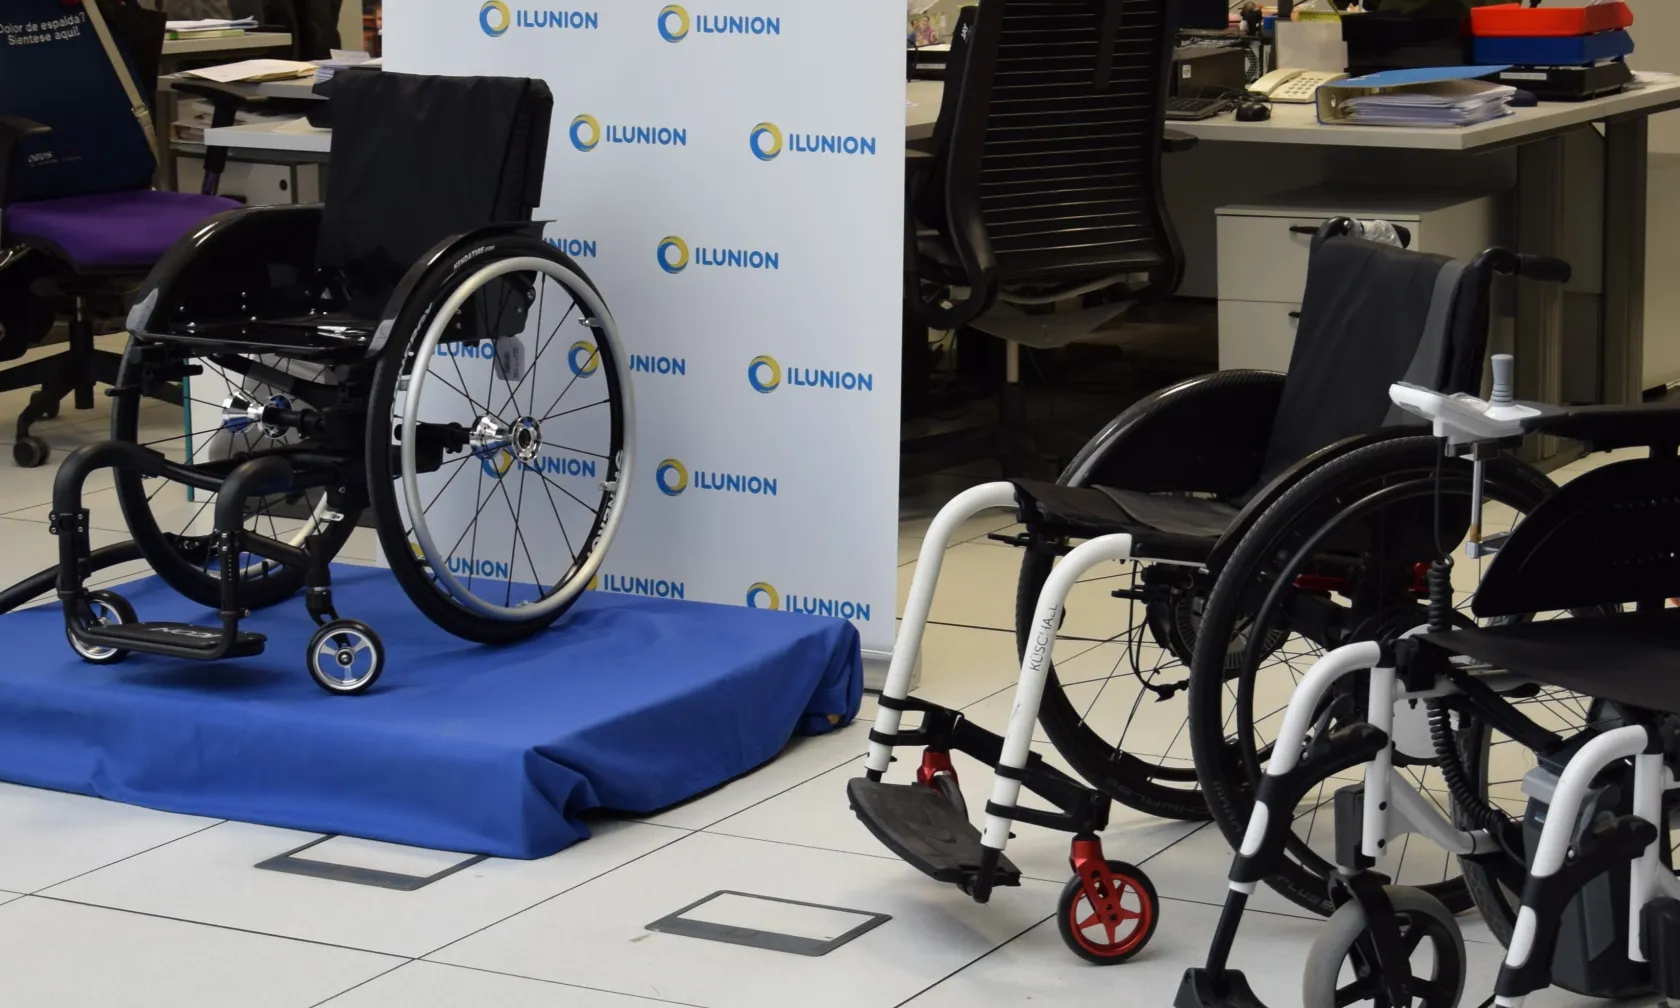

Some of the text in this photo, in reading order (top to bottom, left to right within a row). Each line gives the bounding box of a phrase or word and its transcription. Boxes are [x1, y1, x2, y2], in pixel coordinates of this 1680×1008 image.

[26, 22, 38, 32] de
[40, 11, 86, 30] espalda?
[515, 10, 598, 30] ILUNION
[695, 15, 781, 36] ILUNION
[605, 126, 687, 146] ILUNION
[787, 134, 877, 156] ILUNION
[544, 237, 597, 258] NION
[694, 248, 780, 270] ILUNION
[433, 341, 495, 360] LUNIO
[629, 354, 686, 376] NION
[786, 367, 873, 391] ILUNION
[693, 471, 778, 497] ILUNION
[448, 557, 508, 579] UNION
[604, 574, 684, 600] ILUNION
[786, 594, 870, 621] ILUNION
